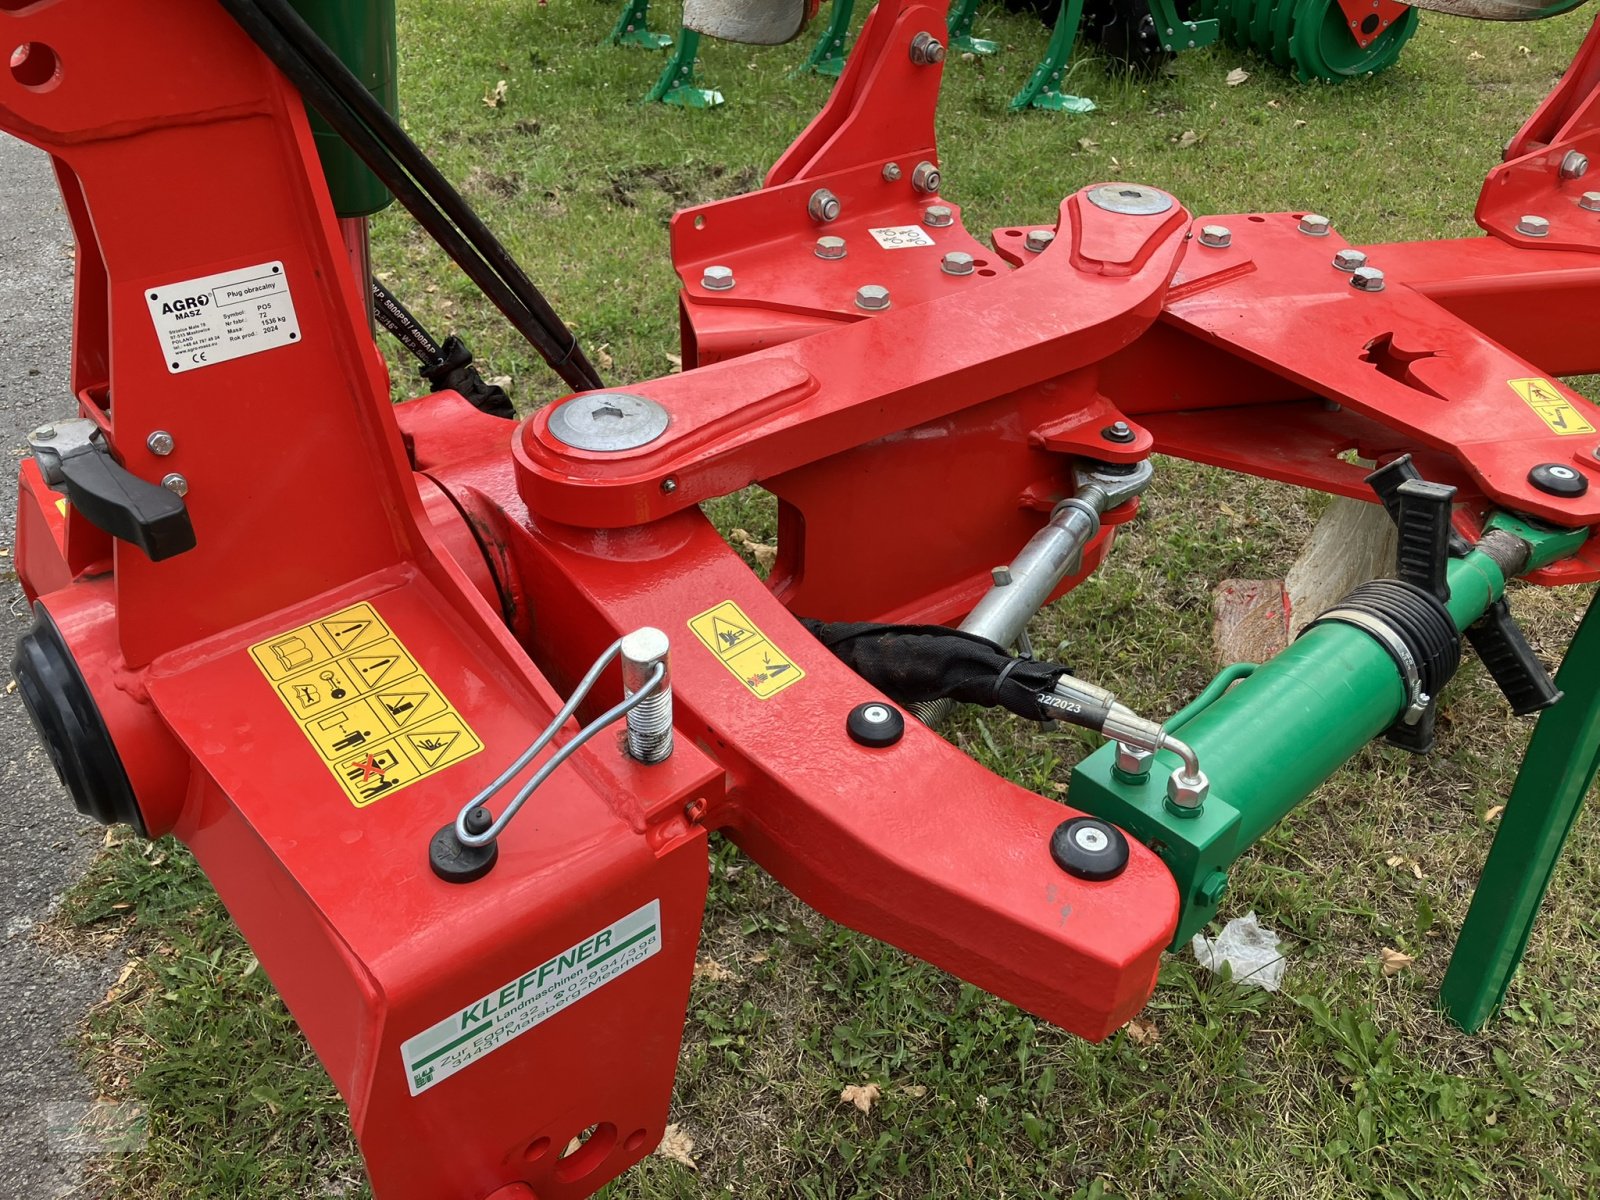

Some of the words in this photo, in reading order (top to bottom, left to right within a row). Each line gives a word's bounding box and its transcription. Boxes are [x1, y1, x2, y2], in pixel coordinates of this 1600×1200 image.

[243, 282, 276, 295] obracalny
[162, 294, 210, 315] AGRO
[175, 309, 202, 321] MASZ
[261, 317, 277, 326] 1536
[172, 336, 193, 345] POLAND
[229, 334, 241, 342] Rok
[263, 325, 279, 334] 2024
[461, 929, 613, 1031] KLEFFNER
[496, 968, 584, 1023] Landmaschinen
[452, 1036, 500, 1068] 34431
[506, 947, 648, 1037] Marsberg-Meerhof
[441, 1047, 468, 1067] Zur
[473, 1020, 515, 1048] Egge
[519, 1005, 539, 1021] 32
